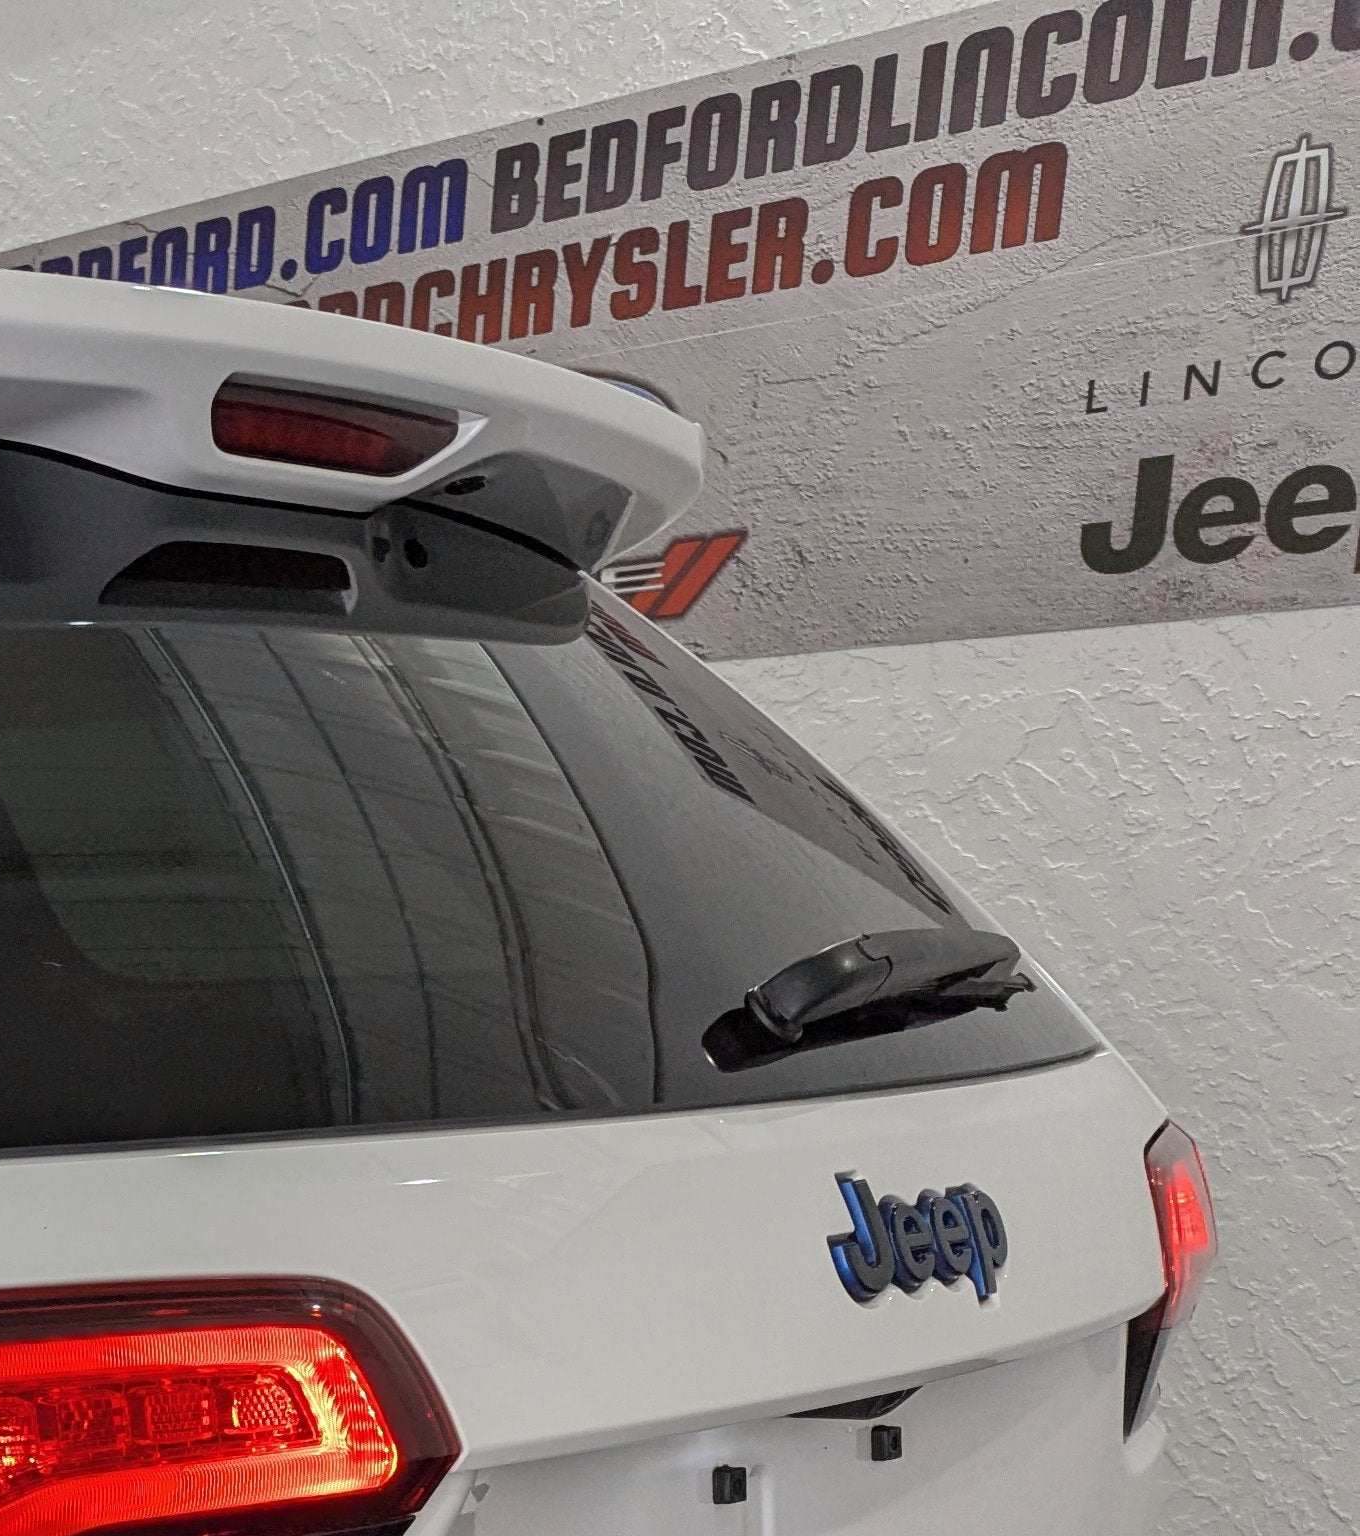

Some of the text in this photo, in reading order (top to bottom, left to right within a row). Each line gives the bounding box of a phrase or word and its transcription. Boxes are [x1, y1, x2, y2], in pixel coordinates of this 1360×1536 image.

[10, 158, 468, 294] FORD.COM
[283, 141, 1068, 345] CHRYSLER.COM
[1080, 454, 1360, 574] Jee
[826, 1169, 1008, 1307] Jeep
